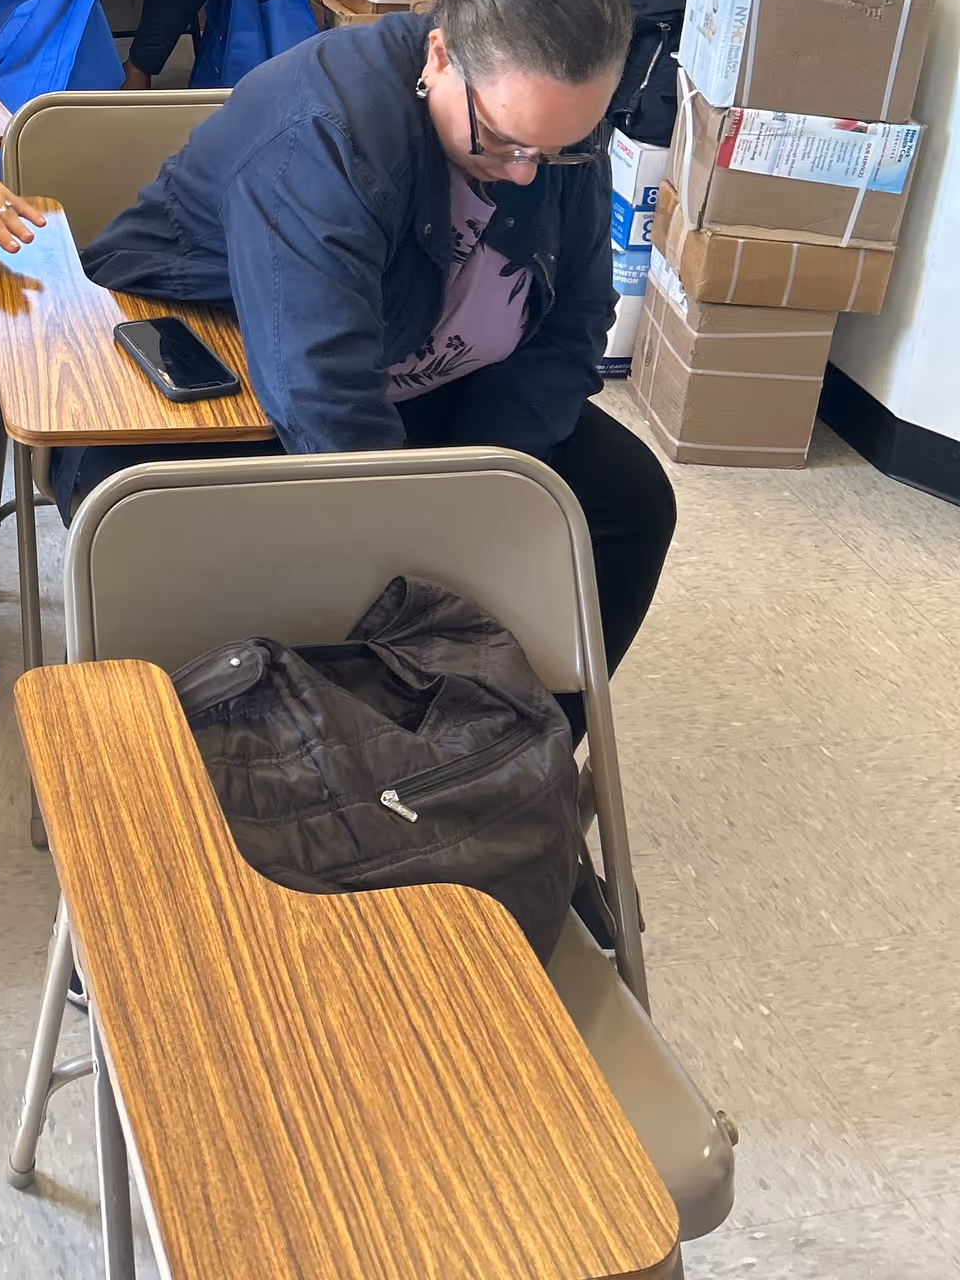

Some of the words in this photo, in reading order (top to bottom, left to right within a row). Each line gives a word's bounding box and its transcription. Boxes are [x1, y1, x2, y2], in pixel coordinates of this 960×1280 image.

[730, 6, 749, 45] NYHC
[901, 128, 912, 149] Health
[908, 129, 917, 144] New
[616, 139, 635, 160] STAPLES
[864, 142, 872, 155] OUR
[897, 149, 906, 164] Care
[904, 144, 913, 159] York
[857, 155, 869, 179] SERVICES
[647, 188, 658, 205] 8
